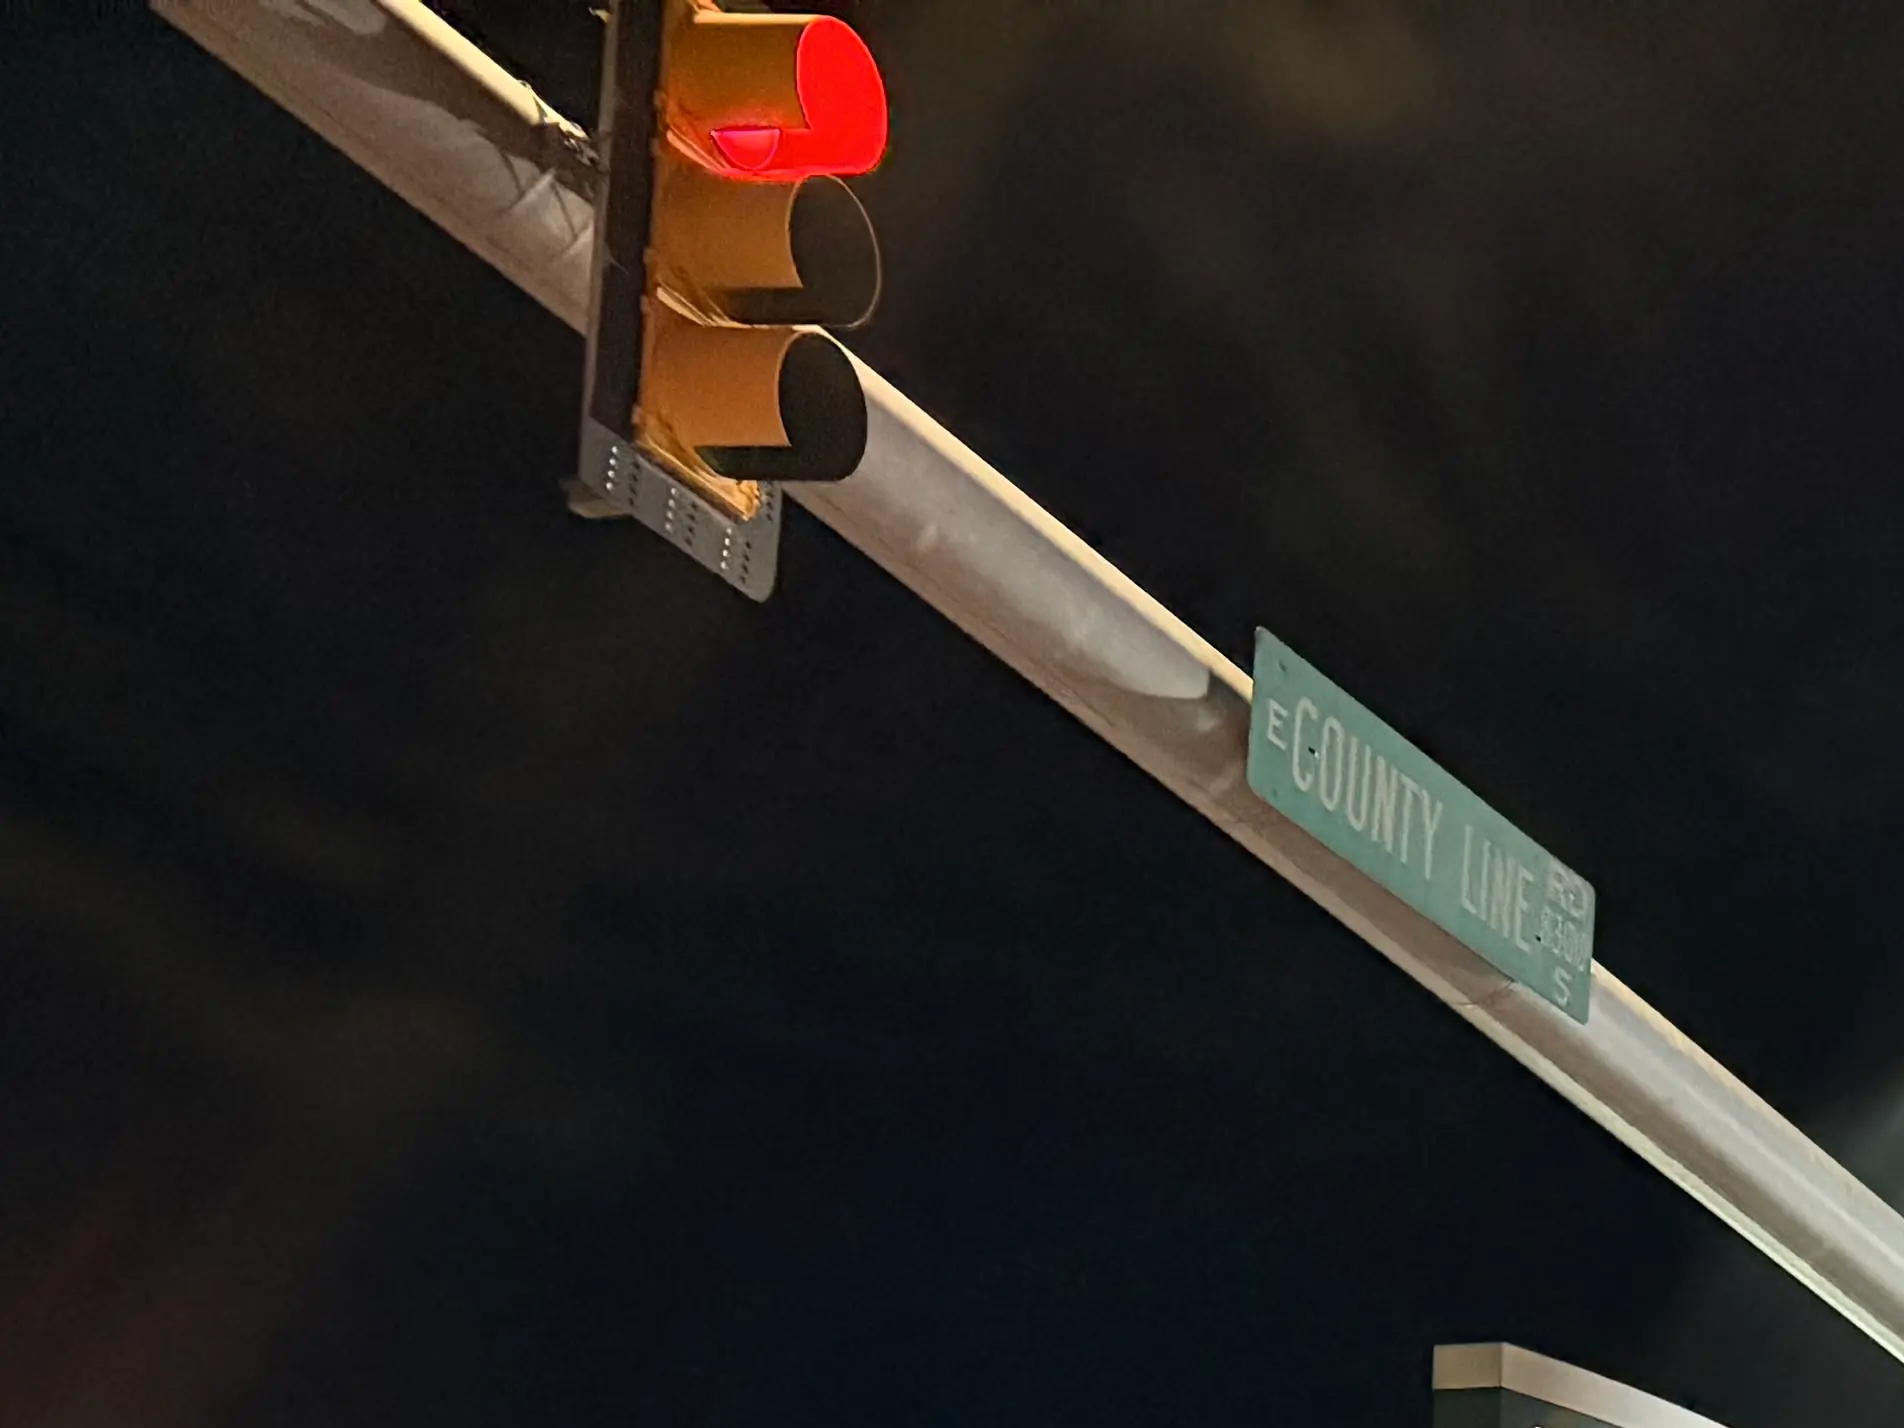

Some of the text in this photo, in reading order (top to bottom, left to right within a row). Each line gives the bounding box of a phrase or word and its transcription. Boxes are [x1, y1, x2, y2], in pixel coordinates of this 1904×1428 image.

[1268, 697, 1534, 953] E COUNTY LINE
[1554, 967, 1571, 1008] S
